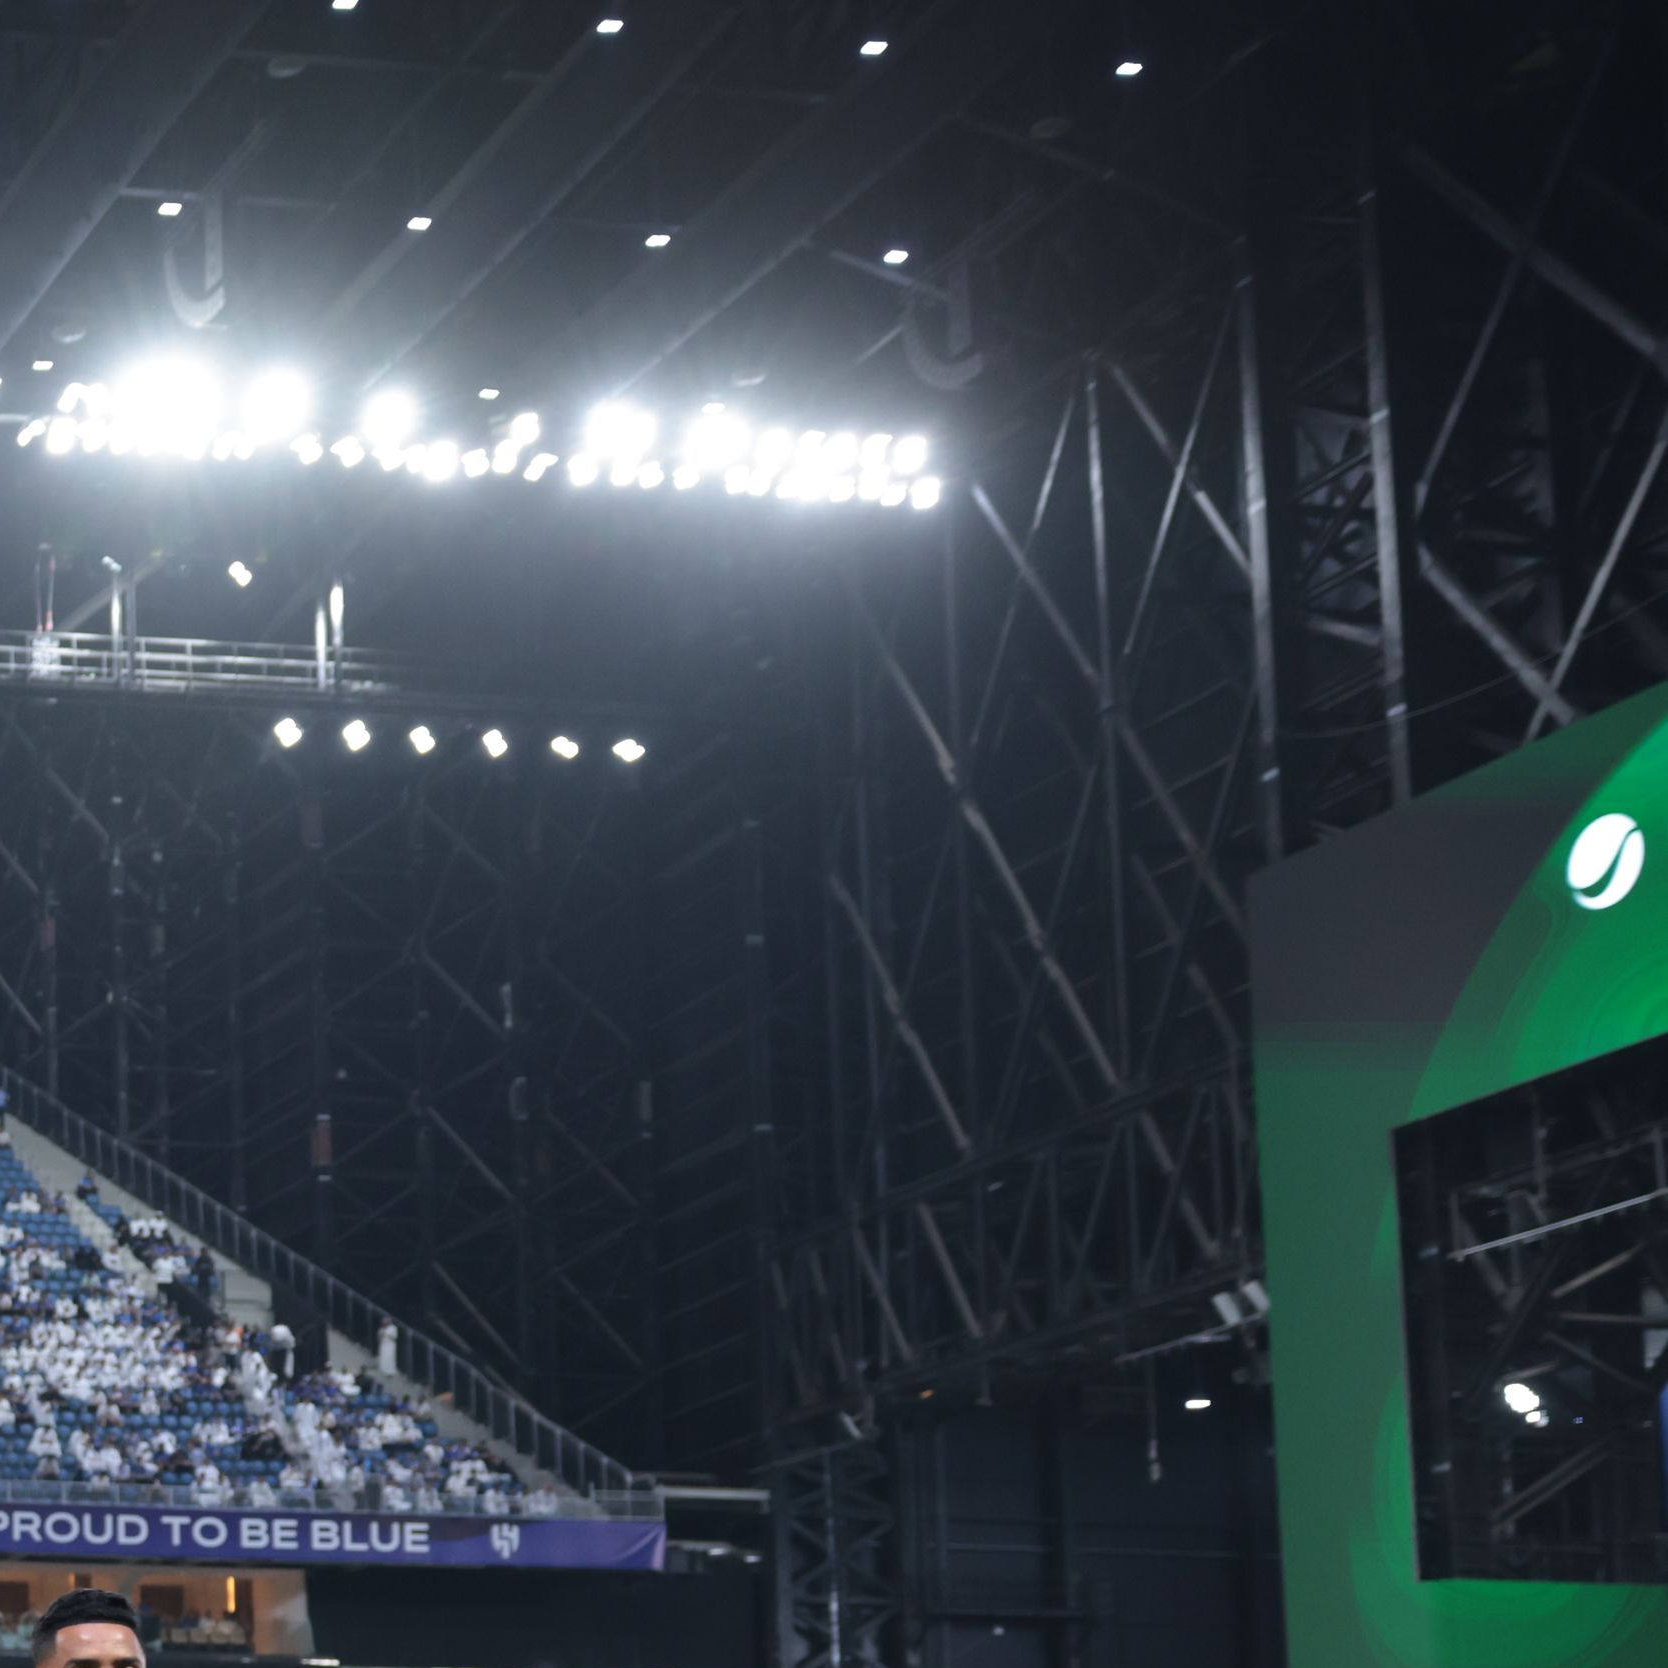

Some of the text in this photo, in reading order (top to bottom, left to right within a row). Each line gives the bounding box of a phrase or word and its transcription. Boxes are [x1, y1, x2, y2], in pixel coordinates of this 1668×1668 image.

[160, 1515, 228, 1549] TO
[240, 1517, 299, 1550] BE
[310, 1519, 430, 1554] BLUE
